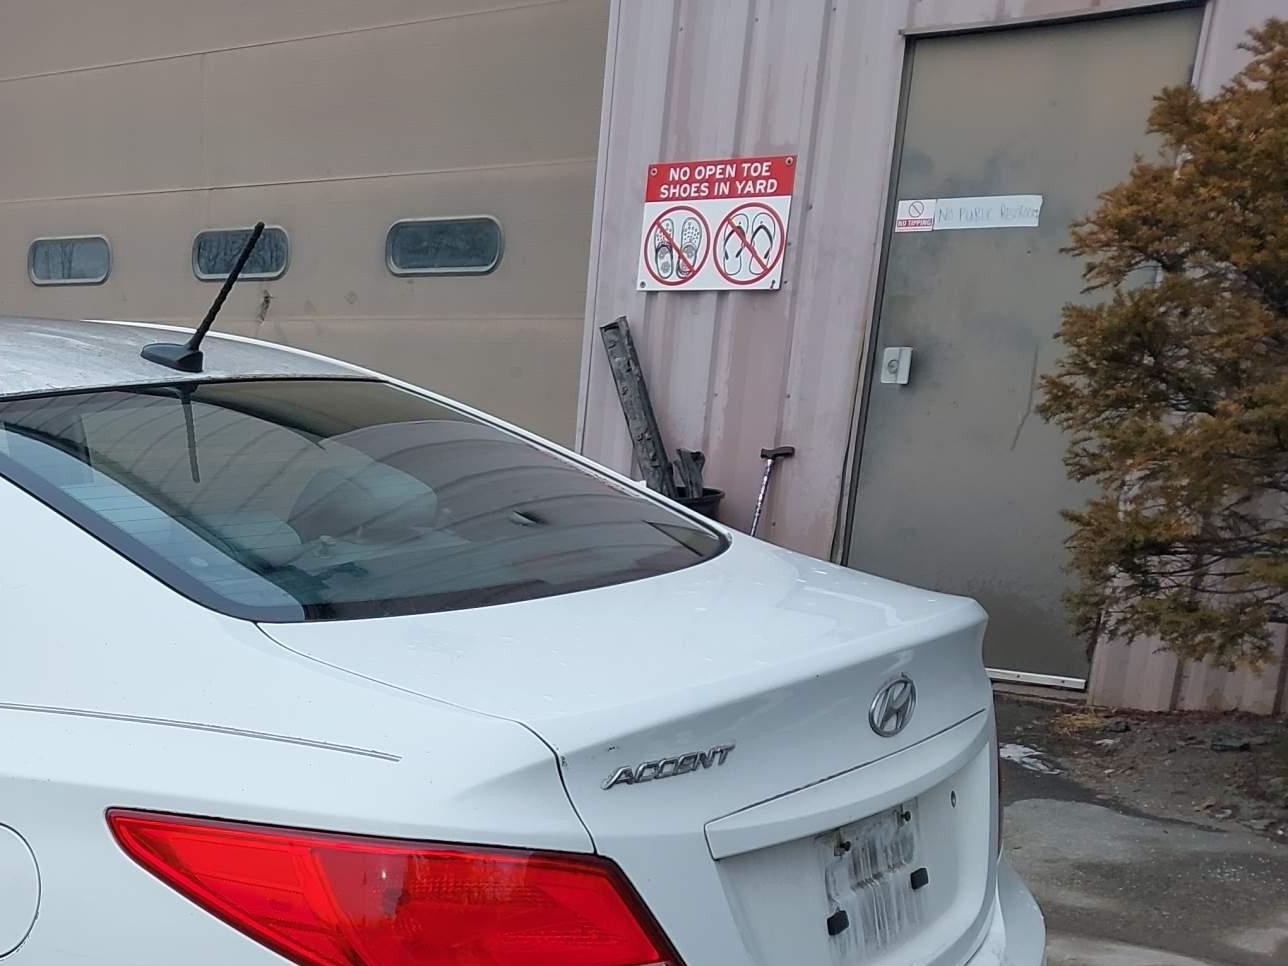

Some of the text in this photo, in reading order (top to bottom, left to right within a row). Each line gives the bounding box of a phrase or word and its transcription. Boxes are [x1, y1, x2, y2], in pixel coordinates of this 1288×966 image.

[669, 162, 771, 181] NO OPEN TOE
[660, 179, 778, 198] SHOES IN YARD
[600, 744, 735, 790] ACCENT
